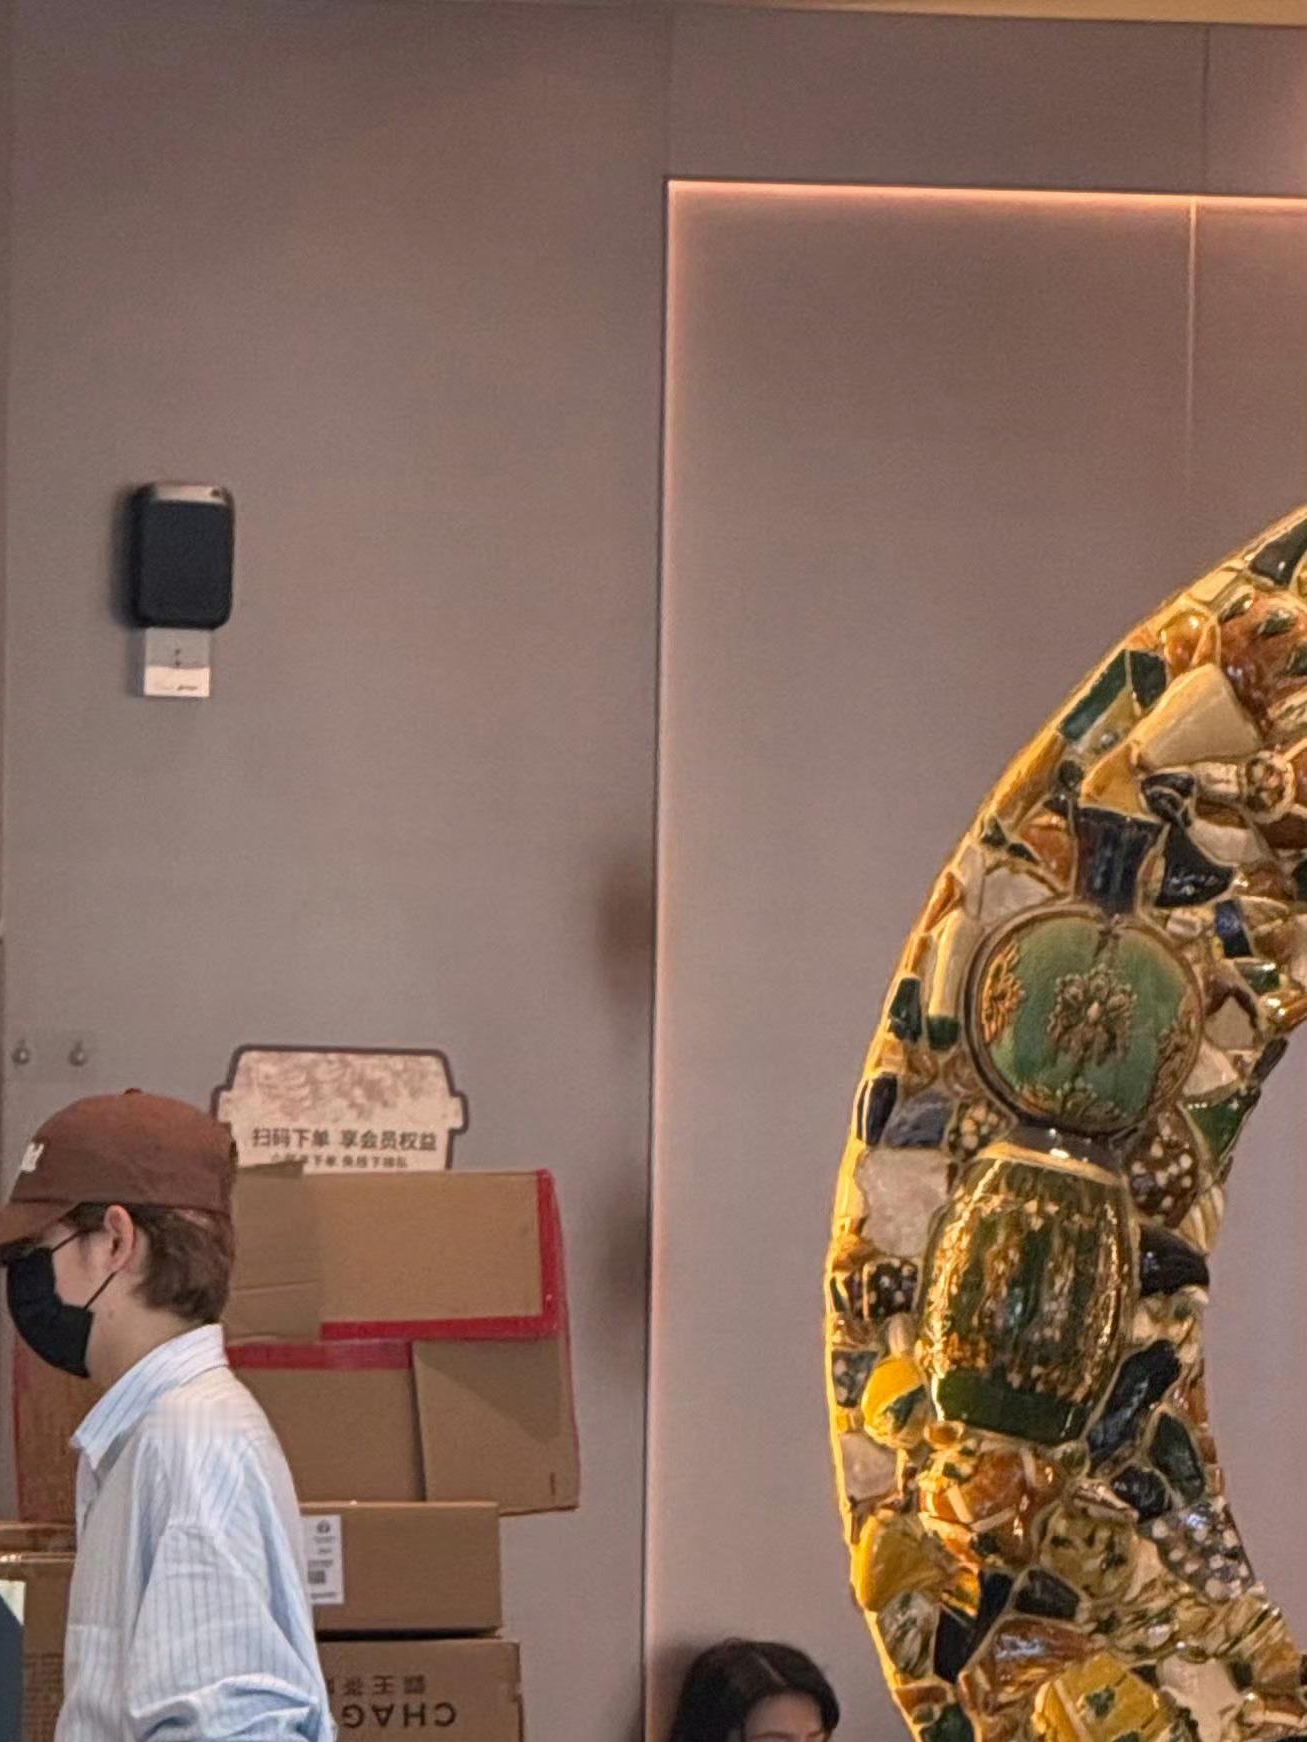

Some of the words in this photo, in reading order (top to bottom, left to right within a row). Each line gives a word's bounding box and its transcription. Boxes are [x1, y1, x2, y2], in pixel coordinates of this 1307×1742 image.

[252, 1128, 330, 1149] 扫码下单
[339, 1131, 437, 1151] 享会员权益
